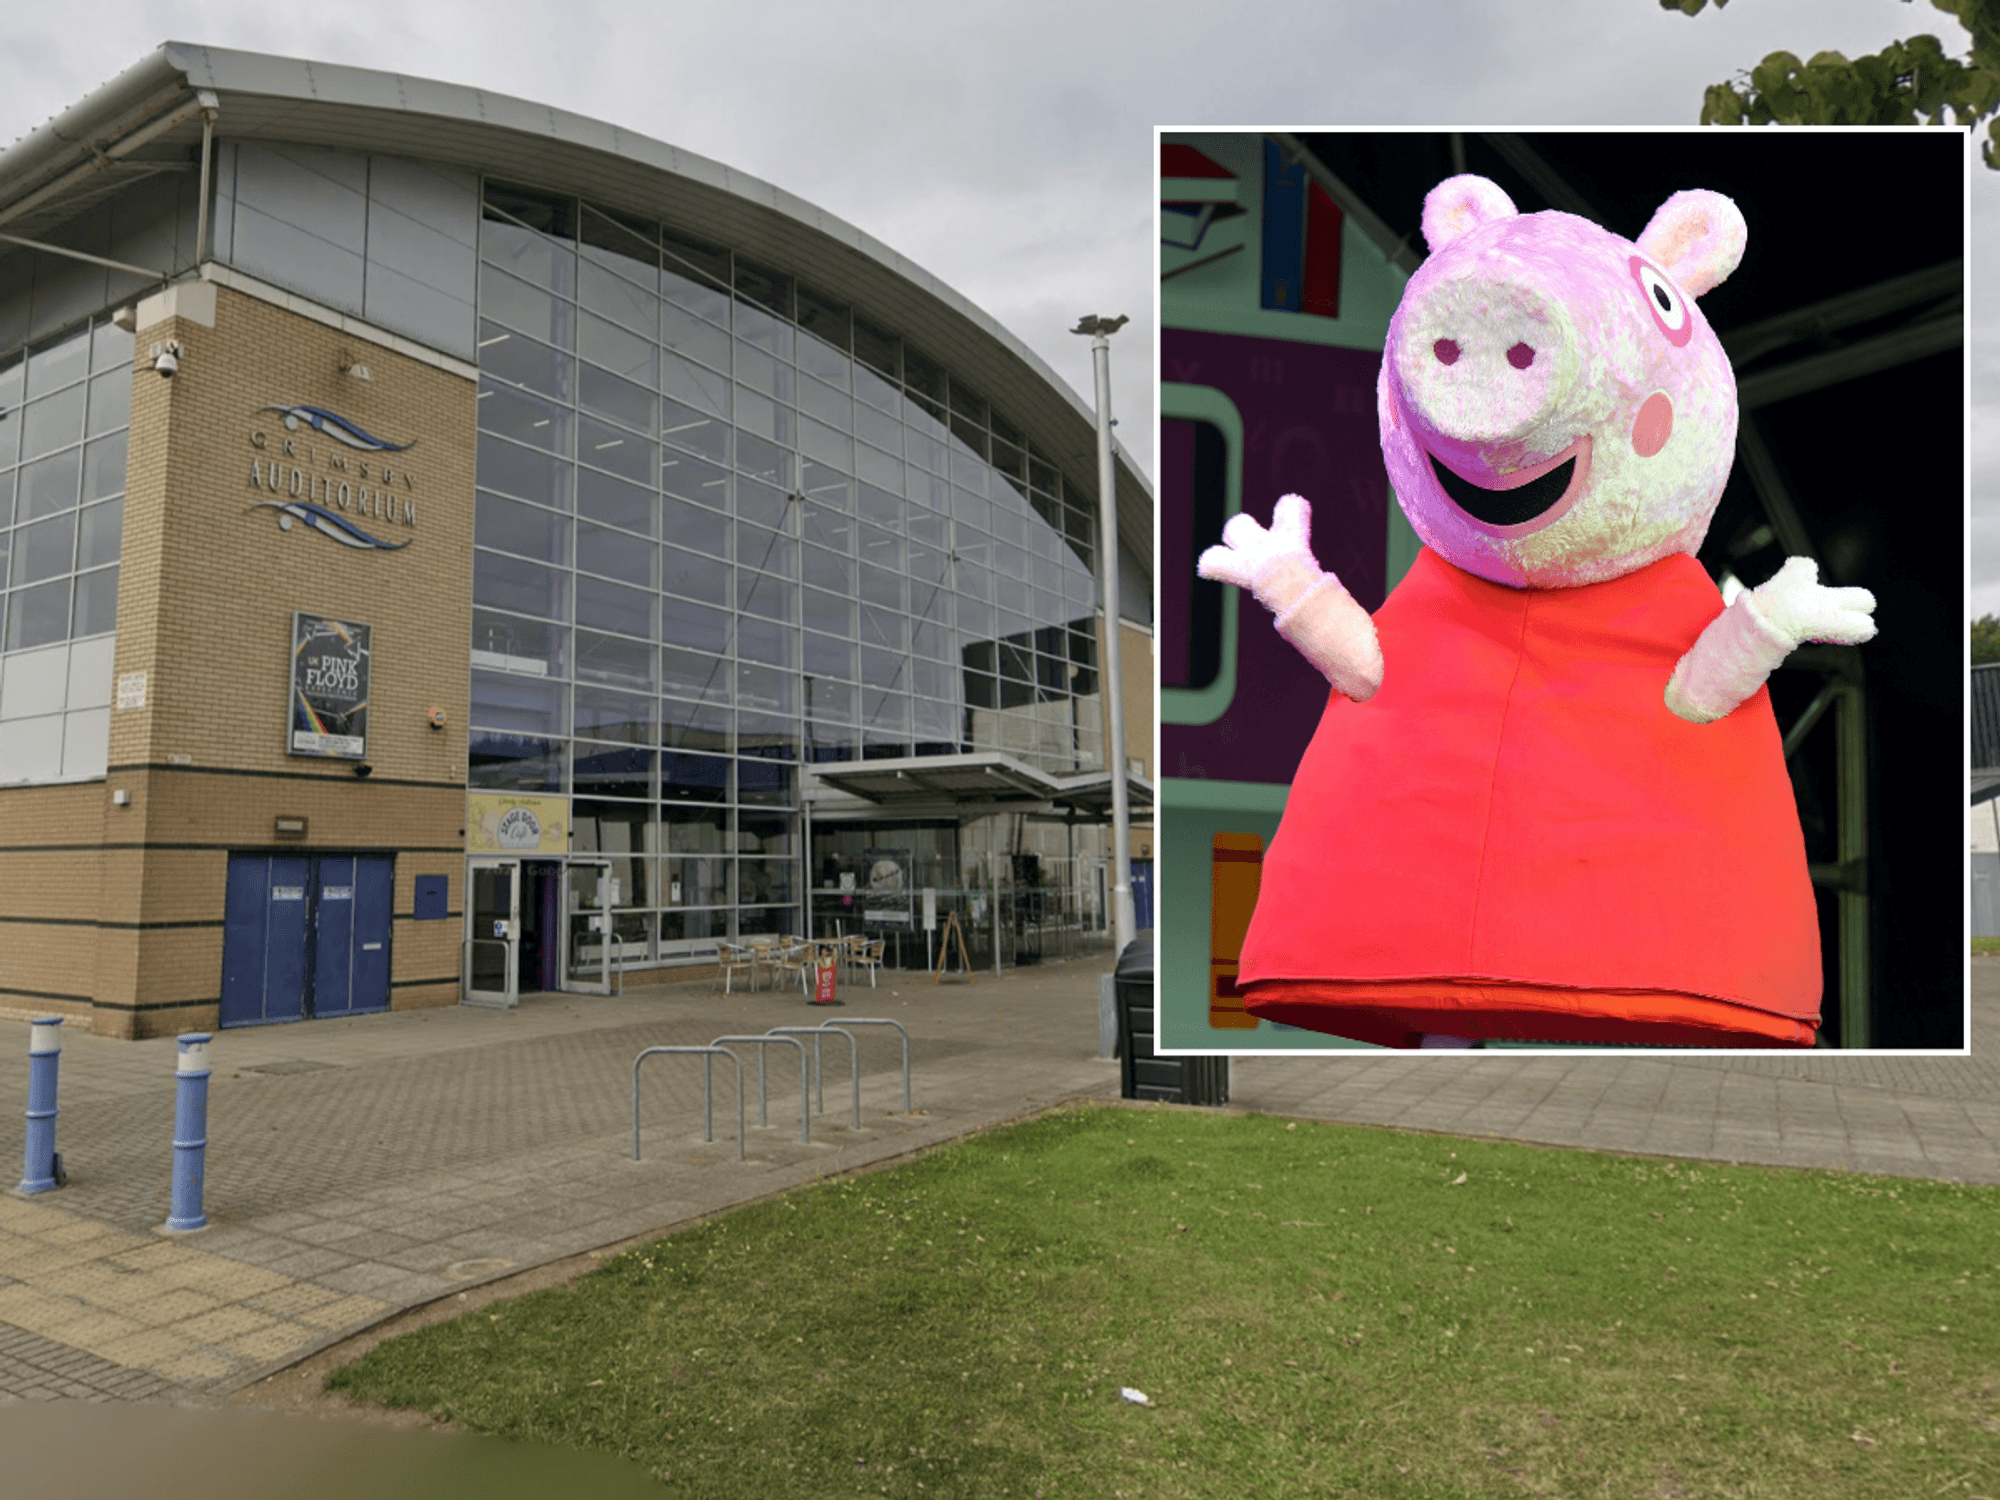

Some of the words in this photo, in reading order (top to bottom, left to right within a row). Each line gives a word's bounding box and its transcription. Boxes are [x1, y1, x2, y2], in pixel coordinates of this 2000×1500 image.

[251, 430, 416, 490] GRIMSBY
[251, 457, 416, 526] AUDITORIUM
[321, 655, 358, 676] PINK
[306, 668, 359, 690] FLOYD
[501, 811, 520, 835] STAGE
[522, 812, 540, 835] DOOR
